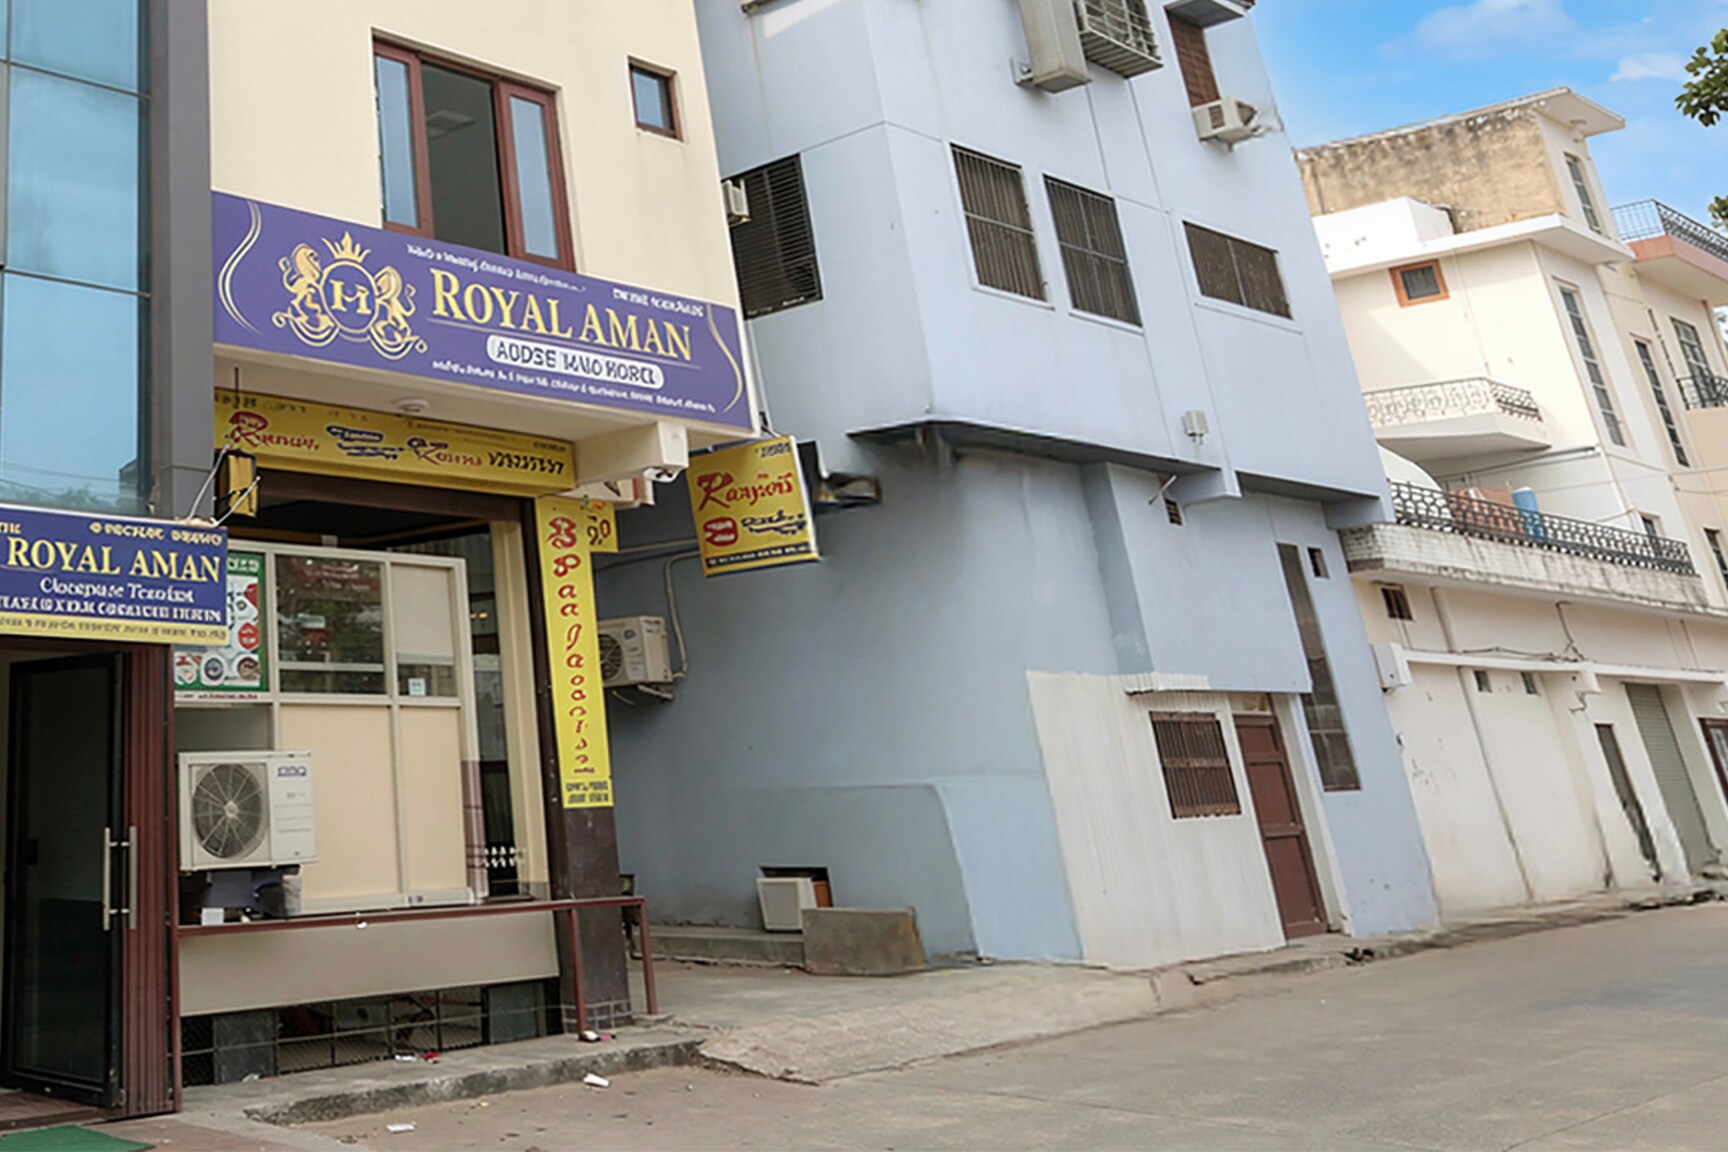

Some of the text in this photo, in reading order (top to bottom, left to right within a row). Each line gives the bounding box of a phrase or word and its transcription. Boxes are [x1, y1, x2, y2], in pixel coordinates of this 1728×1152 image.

[429, 267, 573, 340] ROYAL
[578, 303, 692, 361] AMAN
[6, 536, 121, 576] ROYAL
[128, 549, 221, 584] AMAN
